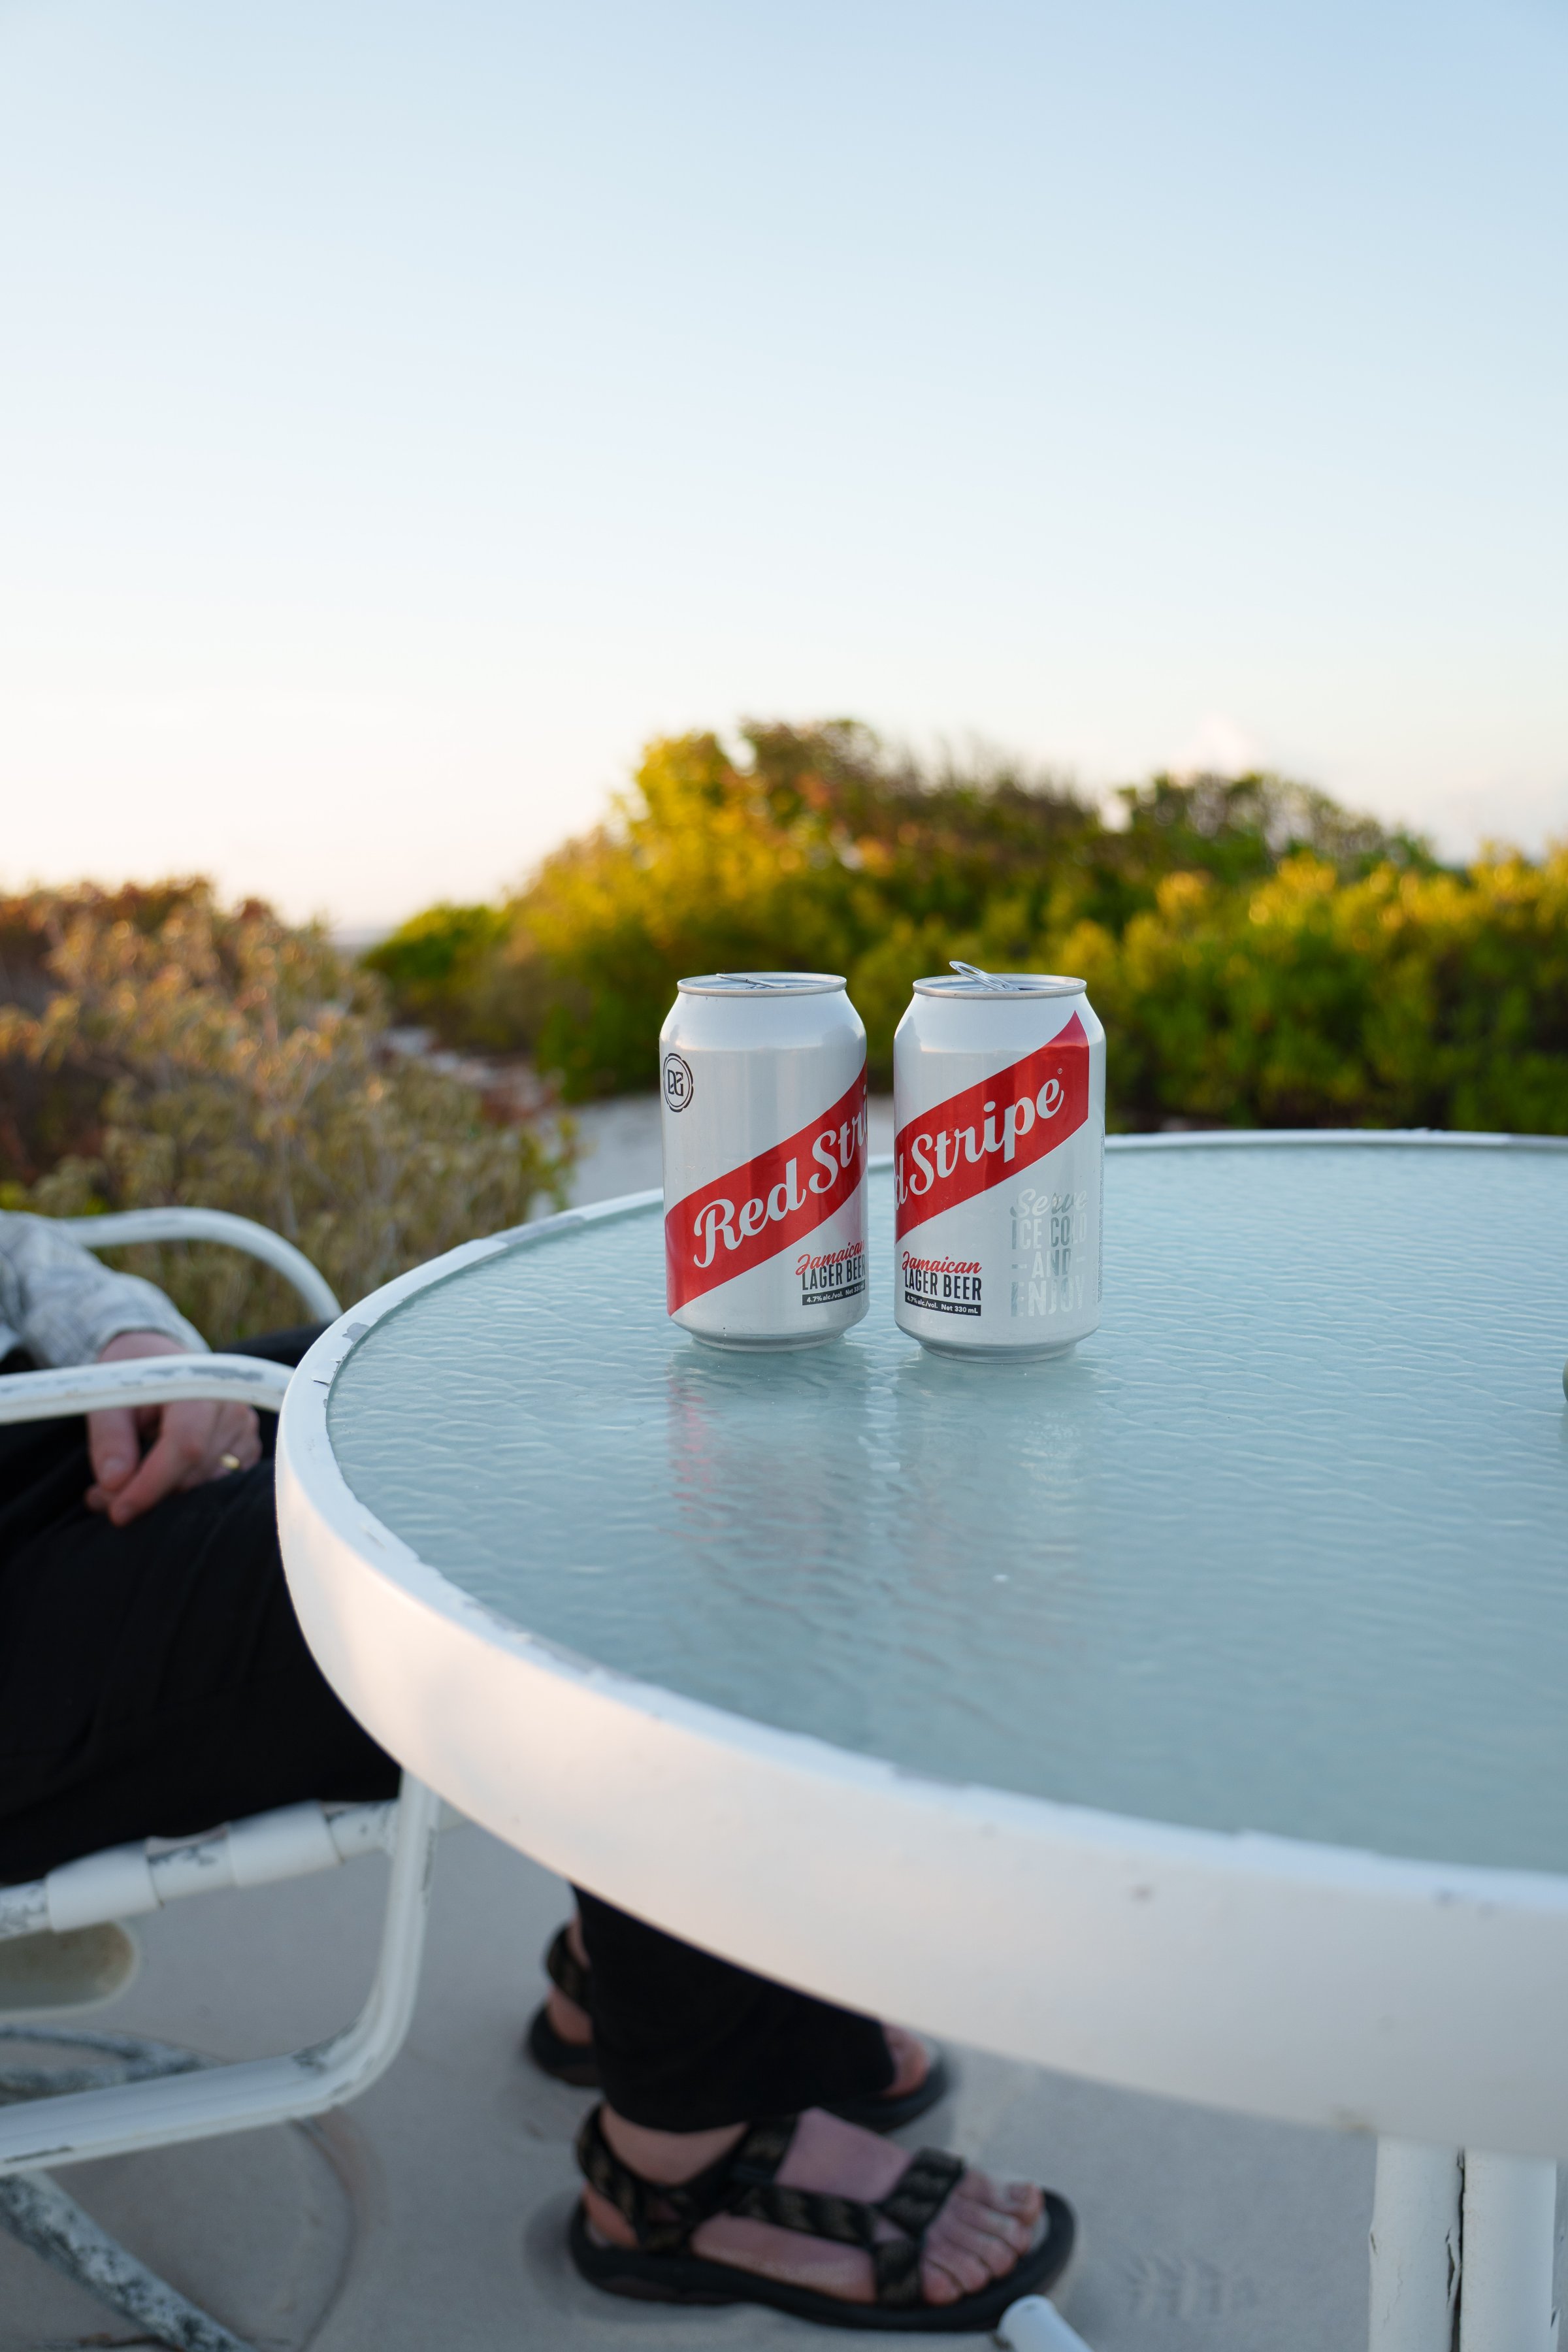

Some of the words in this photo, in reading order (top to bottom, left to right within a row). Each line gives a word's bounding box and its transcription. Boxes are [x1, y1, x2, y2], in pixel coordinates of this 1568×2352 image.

[909, 1079, 1064, 1195] Stripe
[693, 1157, 807, 1267] Red
[1010, 1188, 1088, 1218] Serve
[1012, 1218, 1042, 1250] ICE
[1050, 1213, 1087, 1247] COLD
[795, 1239, 865, 1275] Jamaican
[802, 1262, 843, 1290] LAGER
[847, 1254, 866, 1282] BEER
[902, 1250, 982, 1274] Jamaican
[905, 1267, 938, 1296] LAGER
[943, 1274, 982, 1301] BEER
[1011, 1275, 1085, 1317] ENJOY
